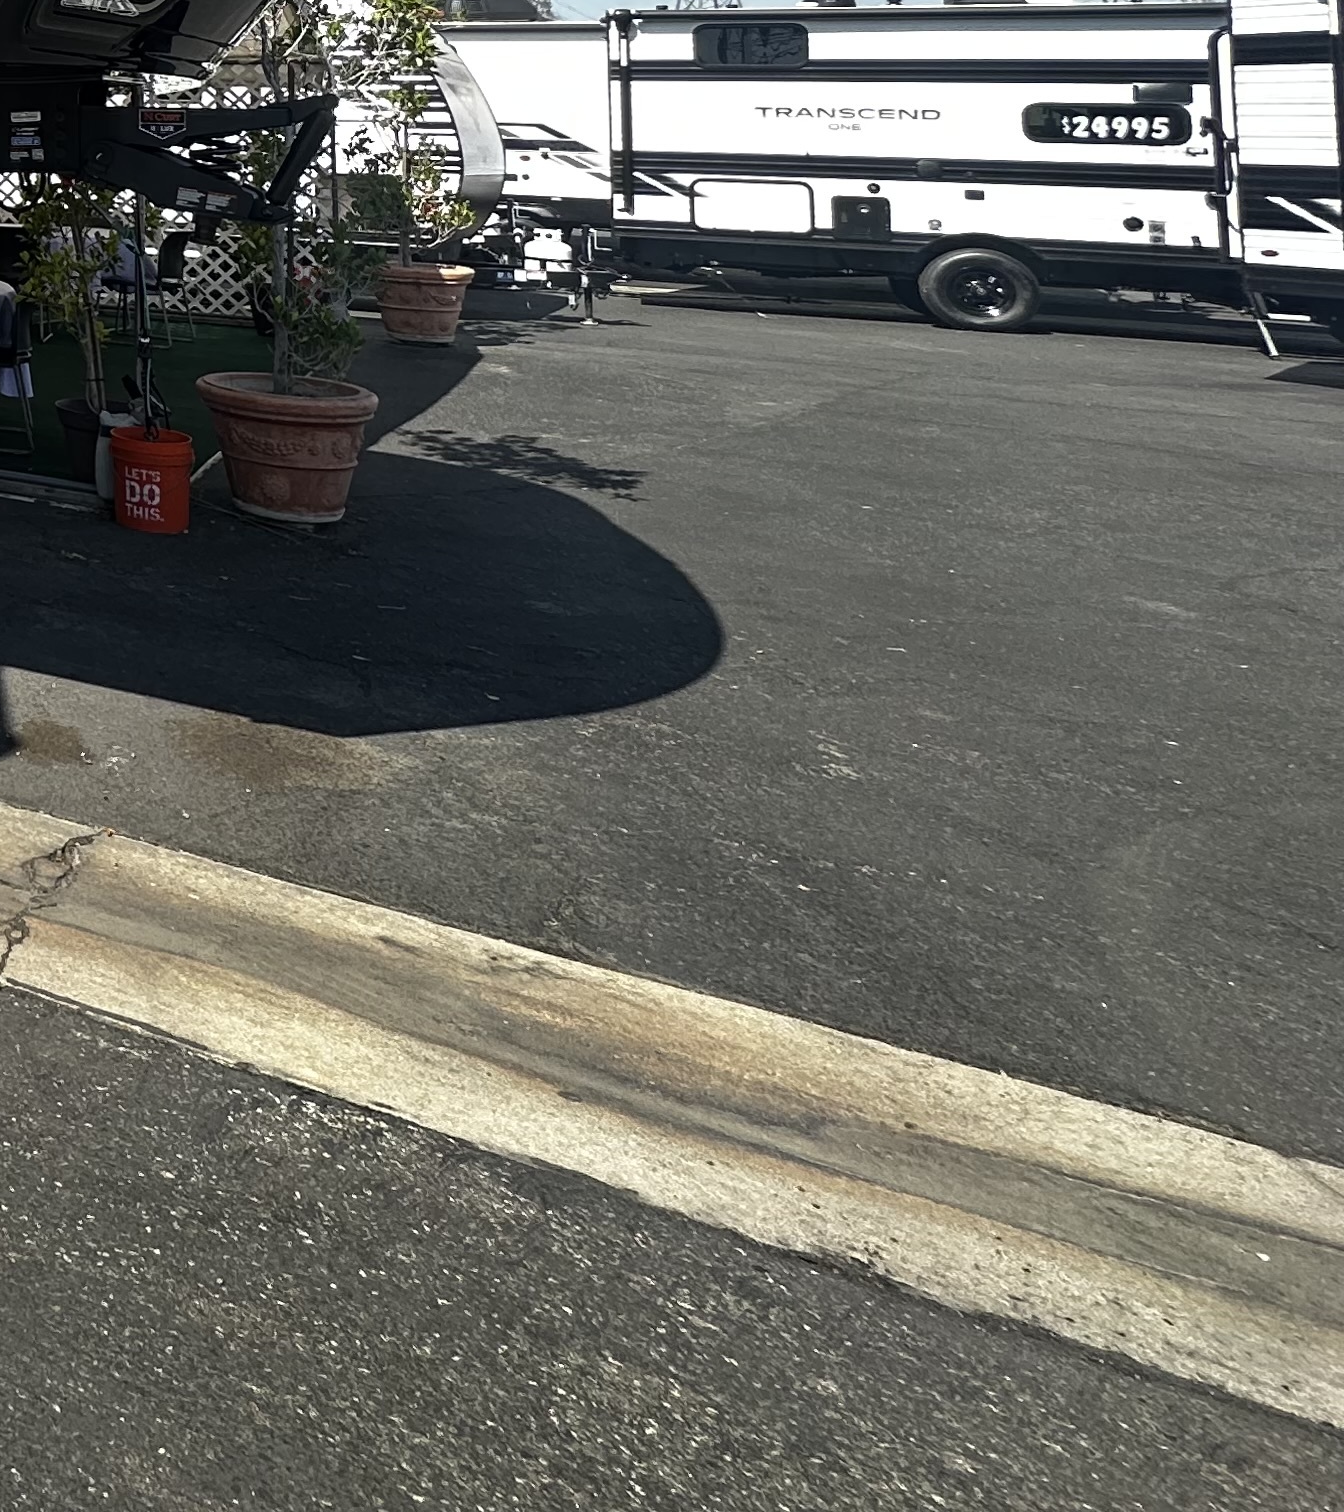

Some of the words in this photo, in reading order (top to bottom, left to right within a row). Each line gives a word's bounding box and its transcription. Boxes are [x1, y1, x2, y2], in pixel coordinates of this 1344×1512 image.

[755, 107, 941, 120] TRANSCEND
[828, 123, 862, 131] ONE
[1061, 115, 1171, 140] $24995
[125, 465, 161, 483] LET'S
[125, 479, 161, 506] DO
